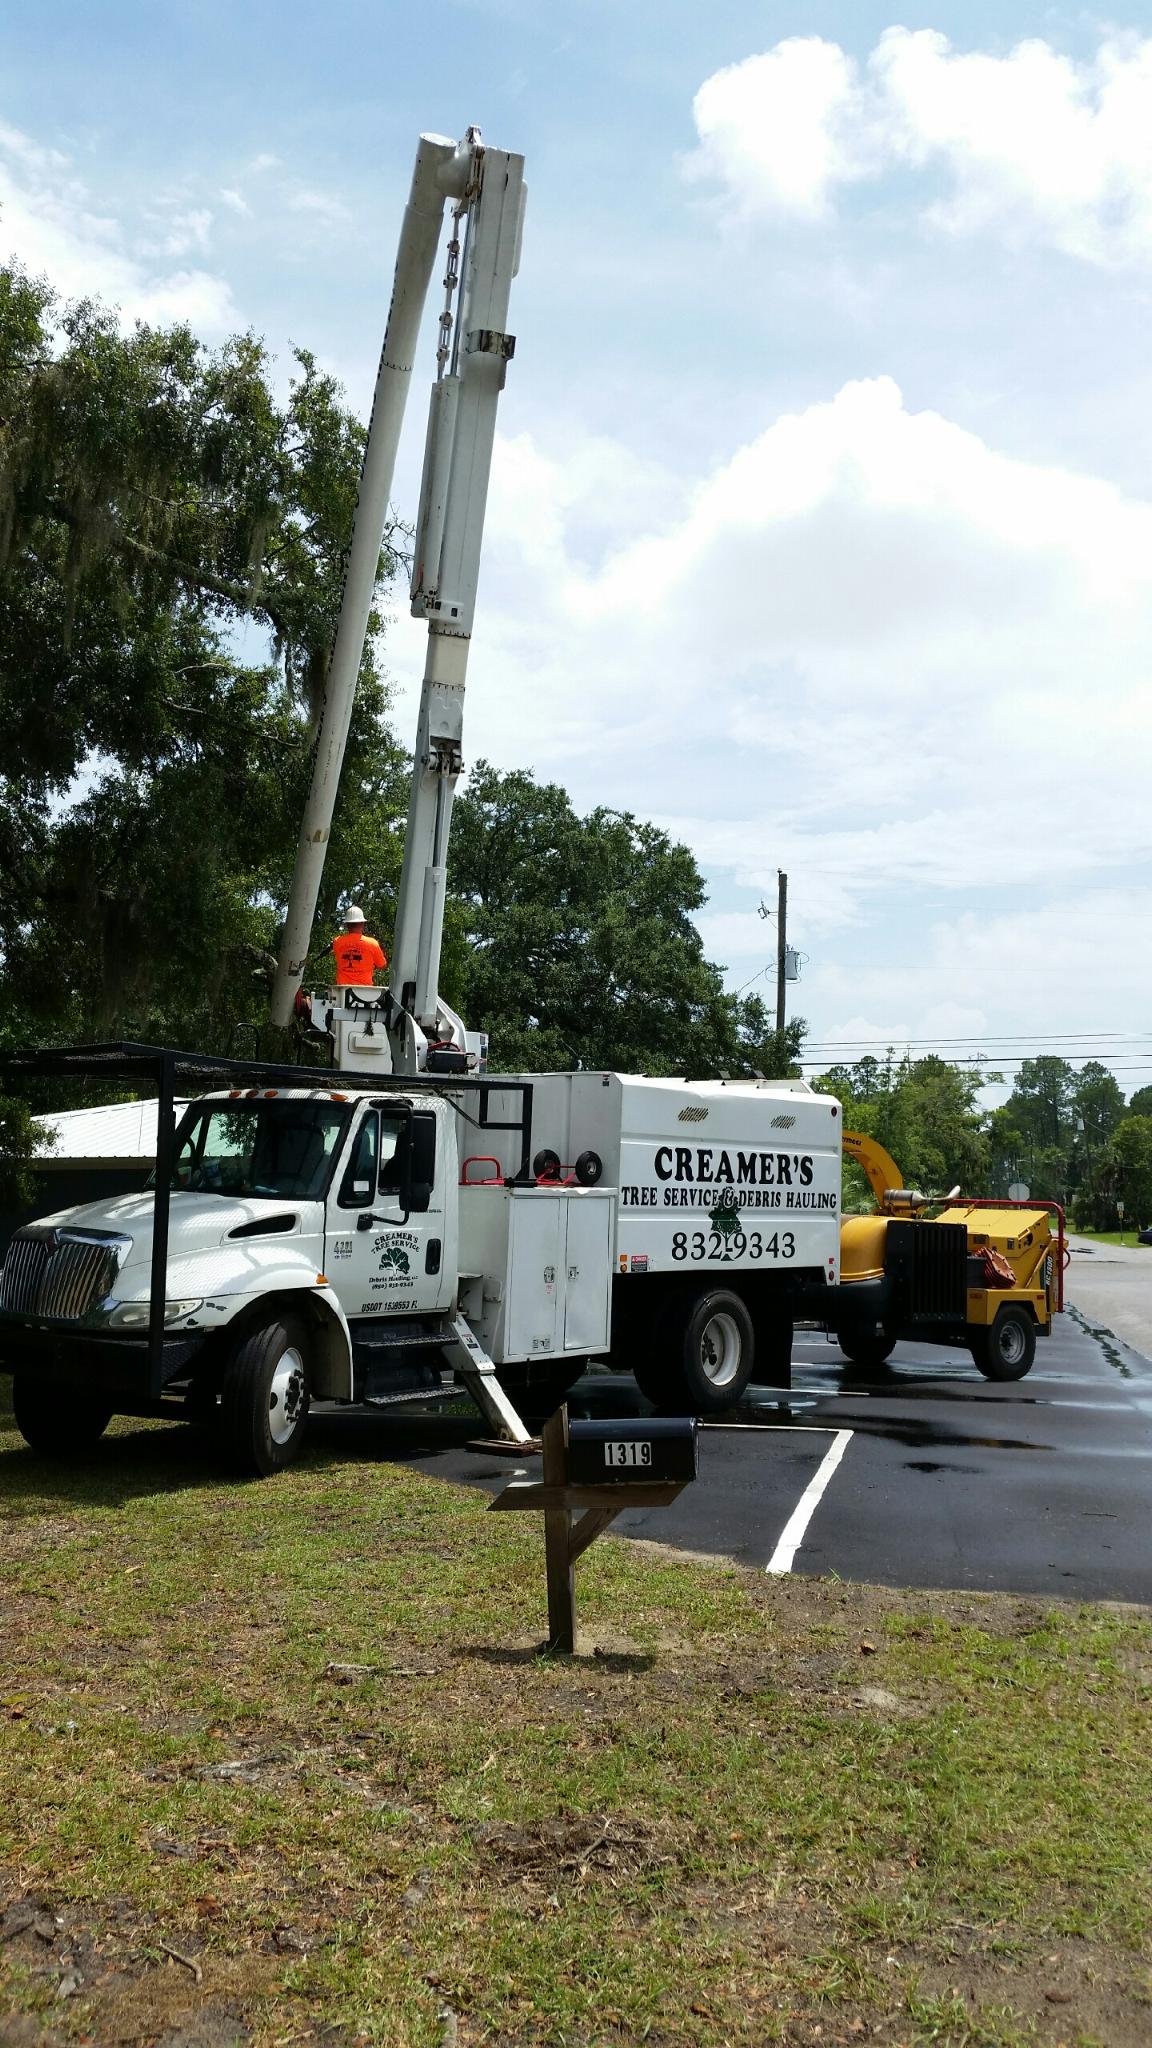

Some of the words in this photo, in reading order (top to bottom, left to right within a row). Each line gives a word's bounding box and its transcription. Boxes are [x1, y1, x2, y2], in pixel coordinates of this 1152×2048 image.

[655, 1146, 814, 1186] CREAMER'S
[621, 1186, 658, 1206] TREE
[663, 1187, 719, 1207] SERVICE
[738, 1190, 781, 1208] DEBRIS
[786, 1191, 837, 1209] HAULING
[371, 1241, 390, 1254] TREE
[391, 1240, 420, 1253] SERVICE
[374, 1232, 419, 1246] CREAMER'S
[361, 1302, 382, 1312] USDOT
[607, 1443, 651, 1465] 1319
